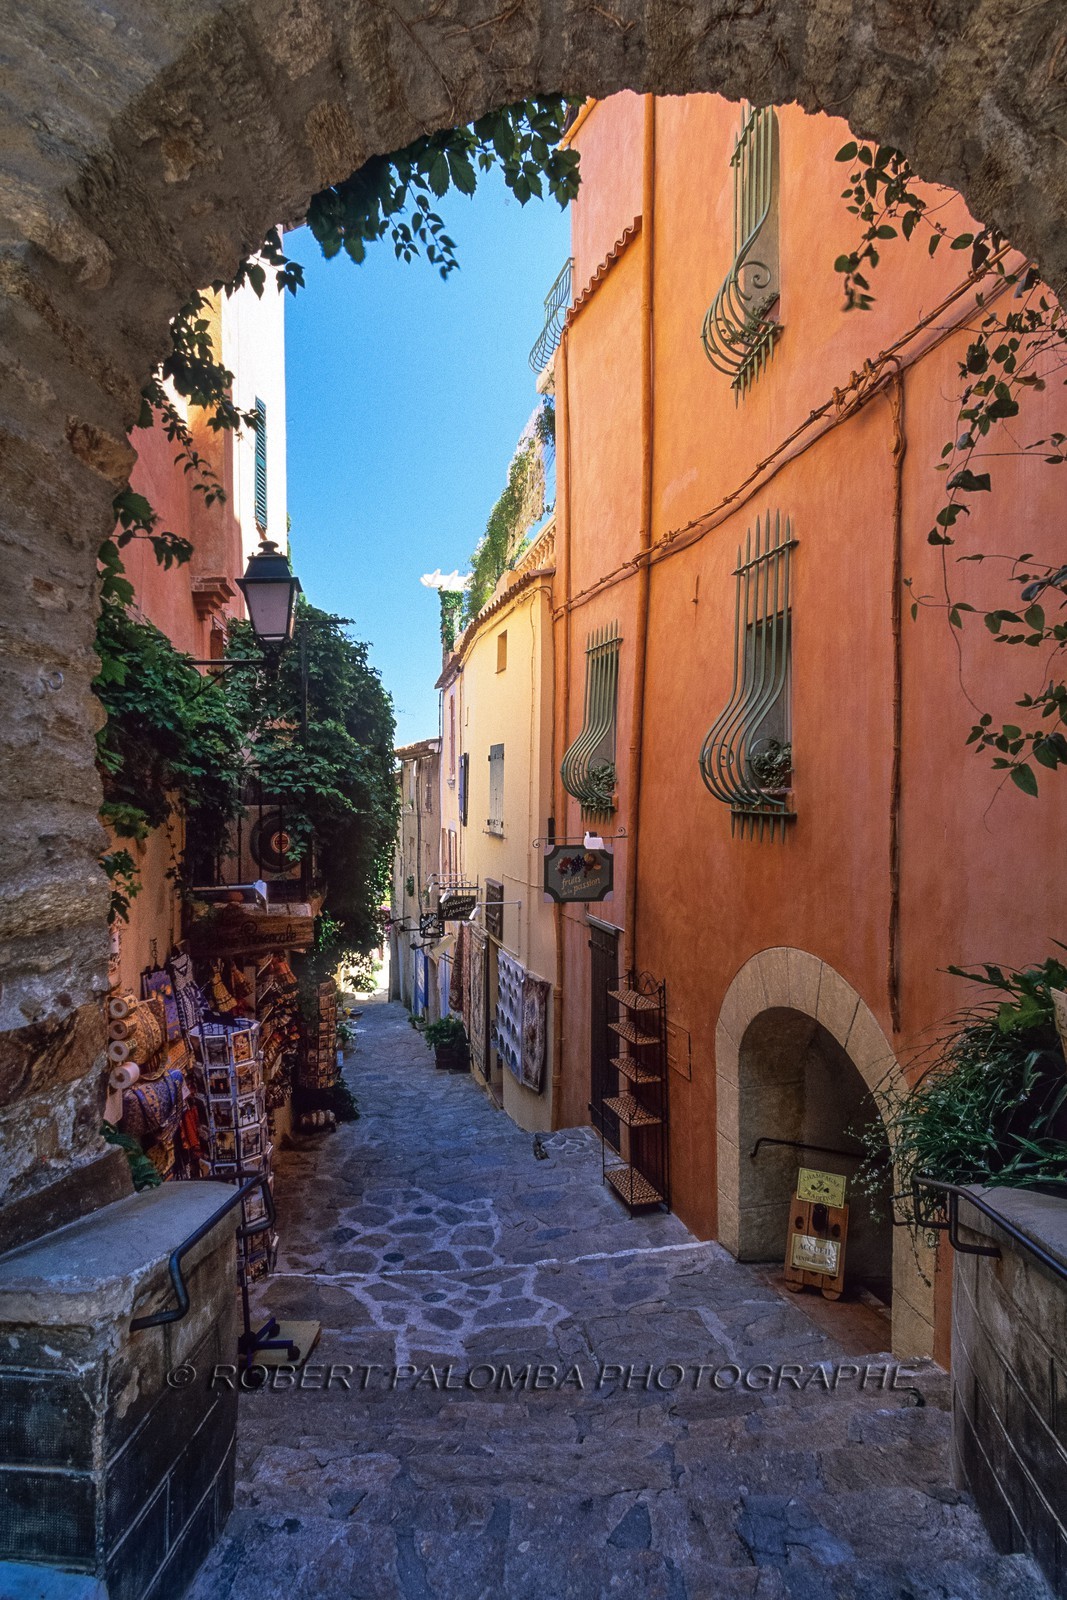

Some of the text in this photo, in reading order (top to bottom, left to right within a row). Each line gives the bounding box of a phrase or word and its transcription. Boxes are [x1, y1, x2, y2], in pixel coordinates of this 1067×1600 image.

[561, 876, 581, 890] fruits
[573, 877, 601, 896] passion
[803, 1173, 840, 1187] CHAMPAGNE
[804, 1187, 837, 1201] TRADITION
[799, 1243, 831, 1255] ACCUEIL
